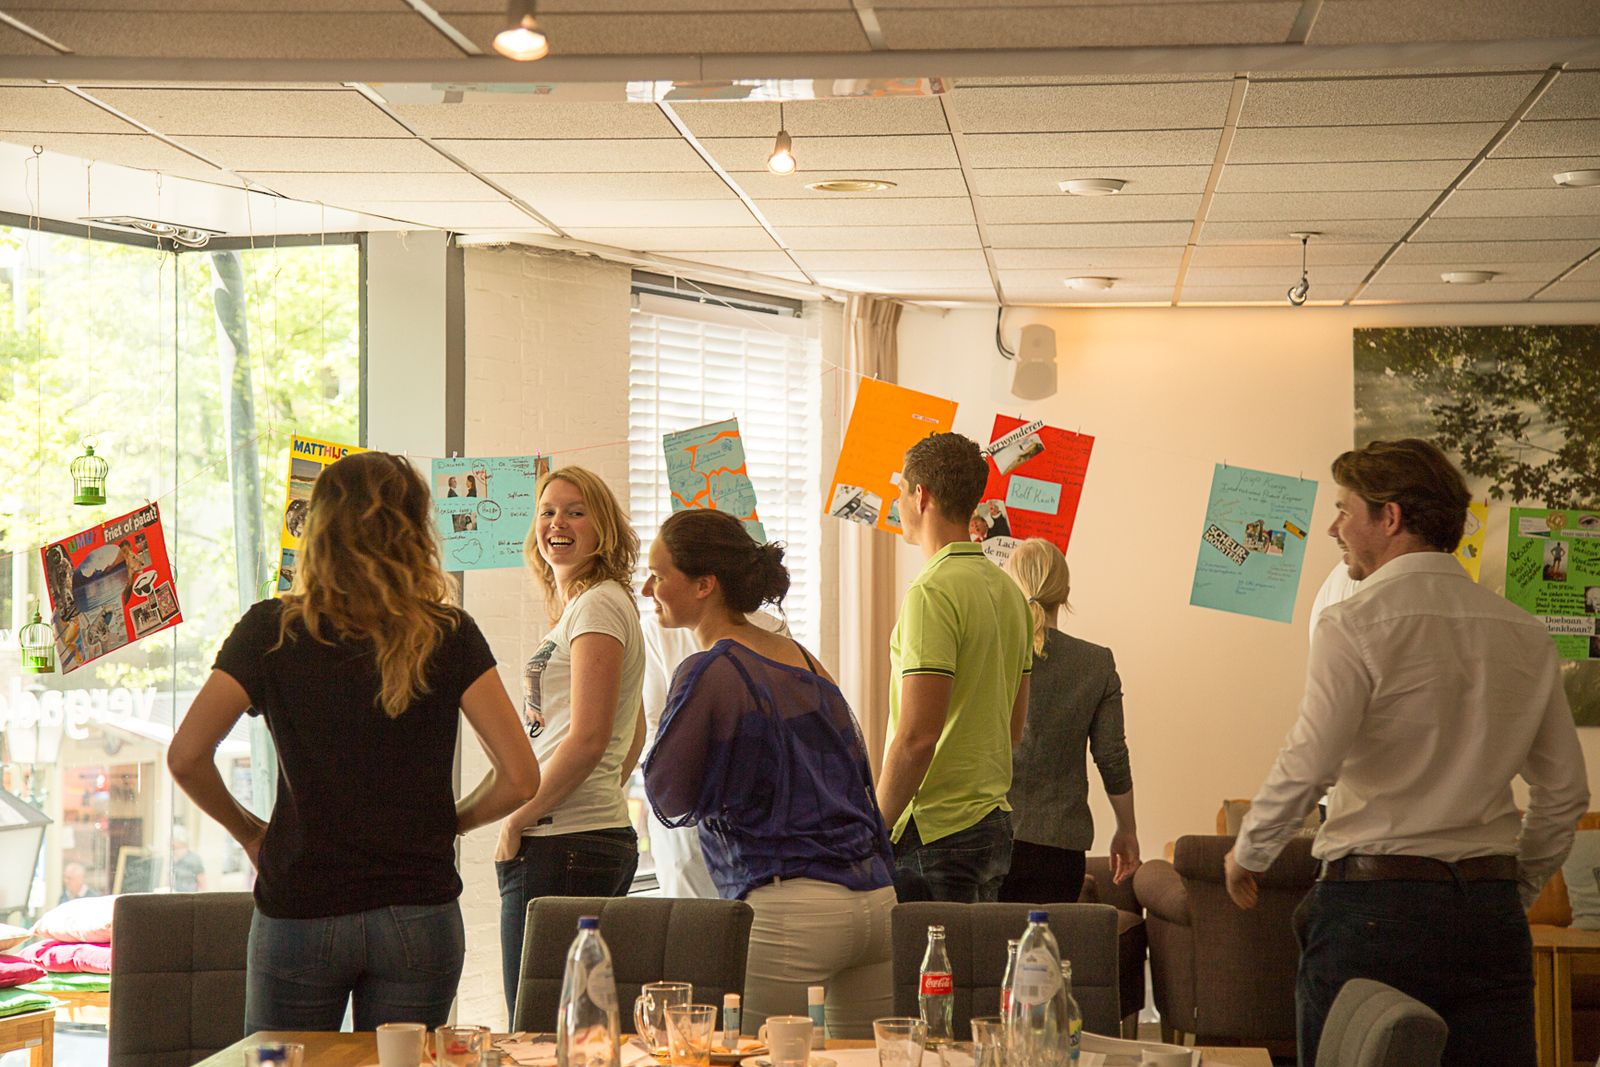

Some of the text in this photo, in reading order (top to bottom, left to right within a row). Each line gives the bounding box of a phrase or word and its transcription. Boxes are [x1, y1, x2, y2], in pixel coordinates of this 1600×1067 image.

[293, 439, 349, 459] MATTHIJS
[987, 420, 1044, 454] verwonderen
[103, 523, 122, 543] Friet
[123, 513, 135, 533] of
[1208, 526, 1247, 559] SCHEUR-
[984, 547, 993, 556] de
[1203, 532, 1243, 565] MONSTERS
